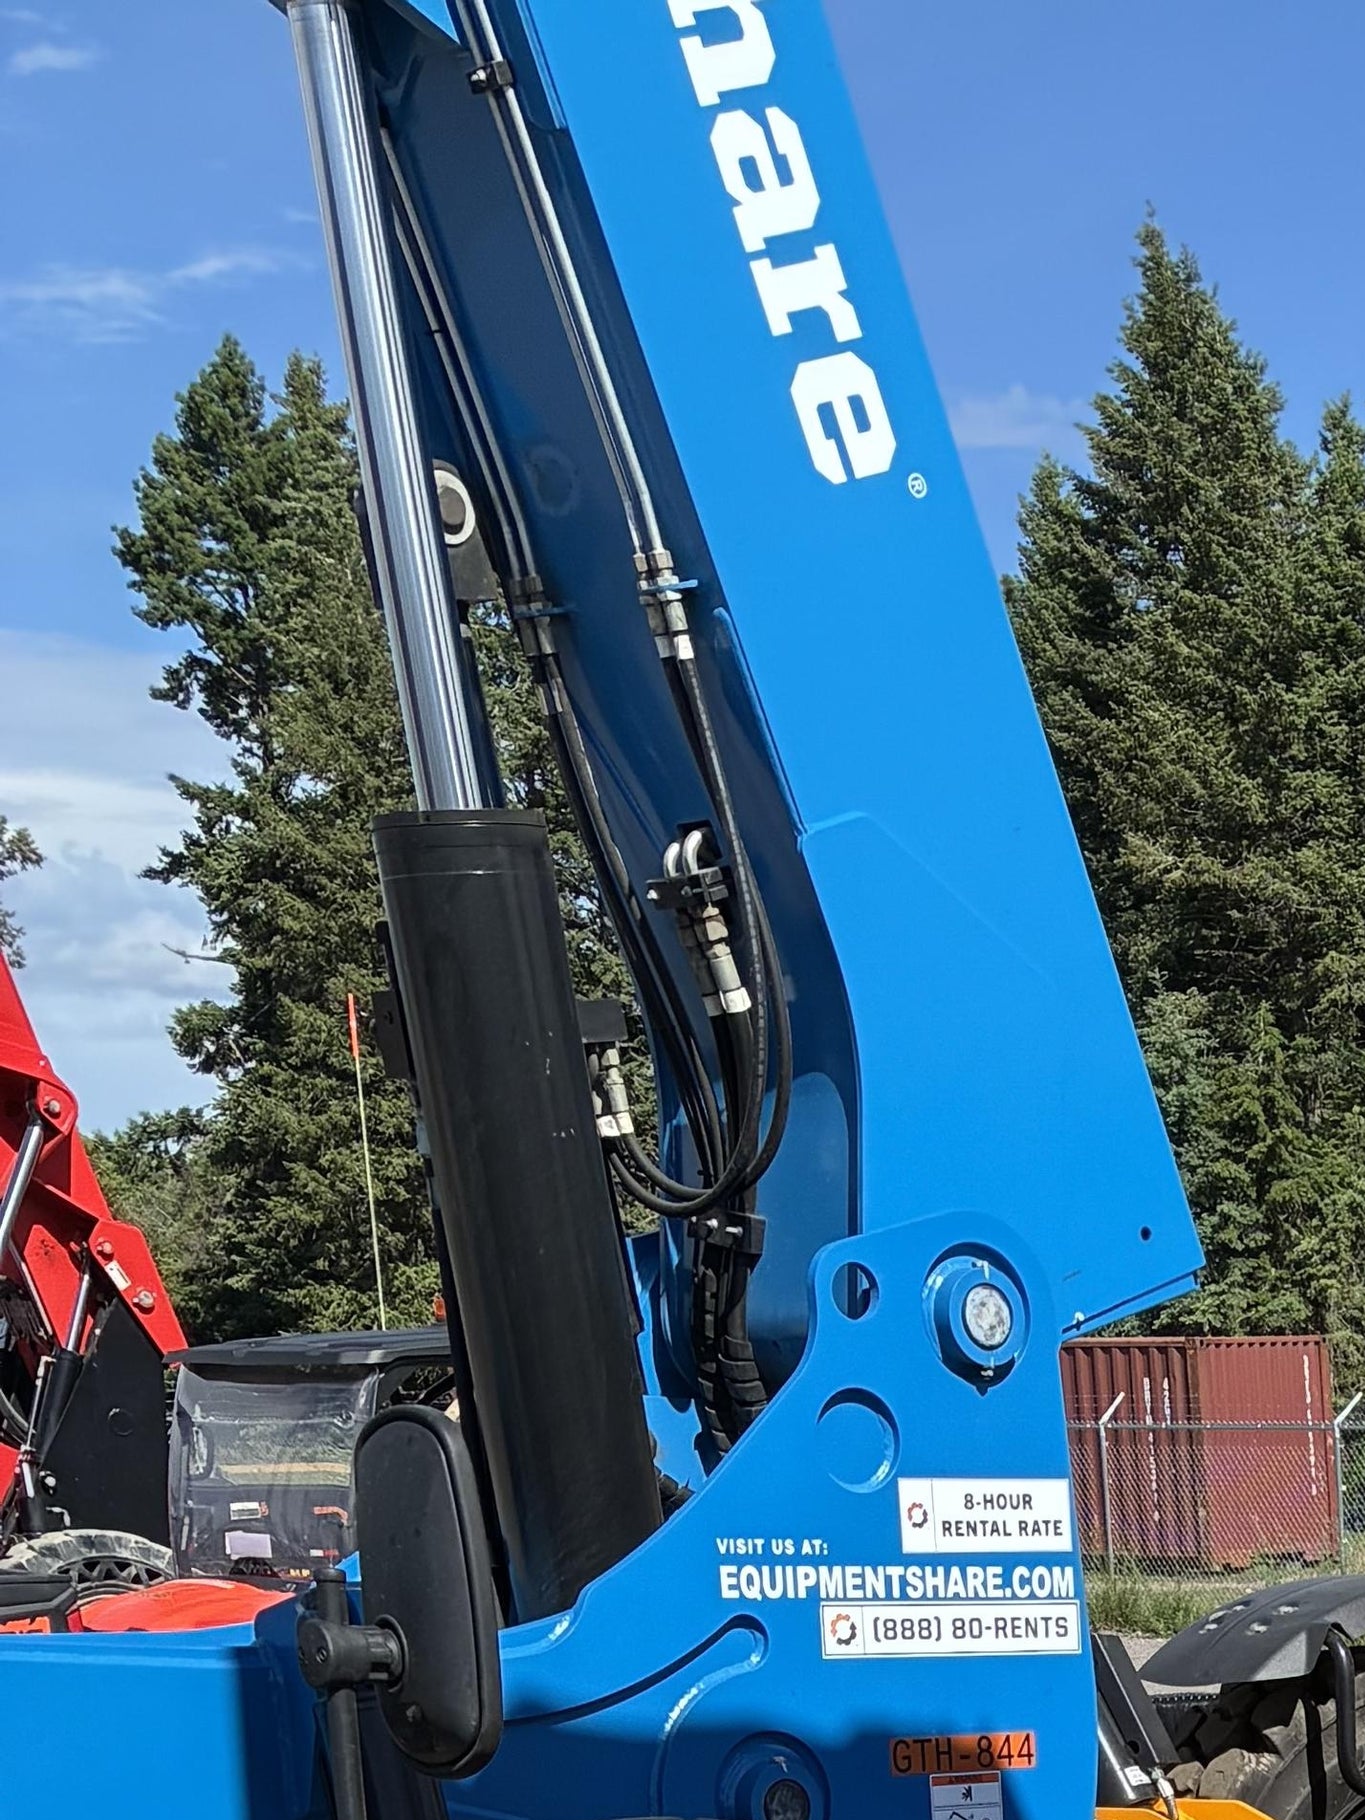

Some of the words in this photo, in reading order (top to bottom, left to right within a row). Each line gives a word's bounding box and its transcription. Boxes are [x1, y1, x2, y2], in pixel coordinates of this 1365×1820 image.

[964, 1492, 1033, 1511] 8-HOUR
[941, 1519, 1011, 1538] RENTAL
[1018, 1519, 1063, 1537] RATE
[716, 1538, 766, 1555] VISIT
[772, 1538, 795, 1555] US
[801, 1538, 828, 1555] AT:
[720, 1564, 1075, 1601] EQUIPMENTSHARE.COM
[873, 1616, 941, 1643] (888)
[951, 1616, 1069, 1641] 80-RENTS
[891, 1734, 1034, 1775] GTH-844
